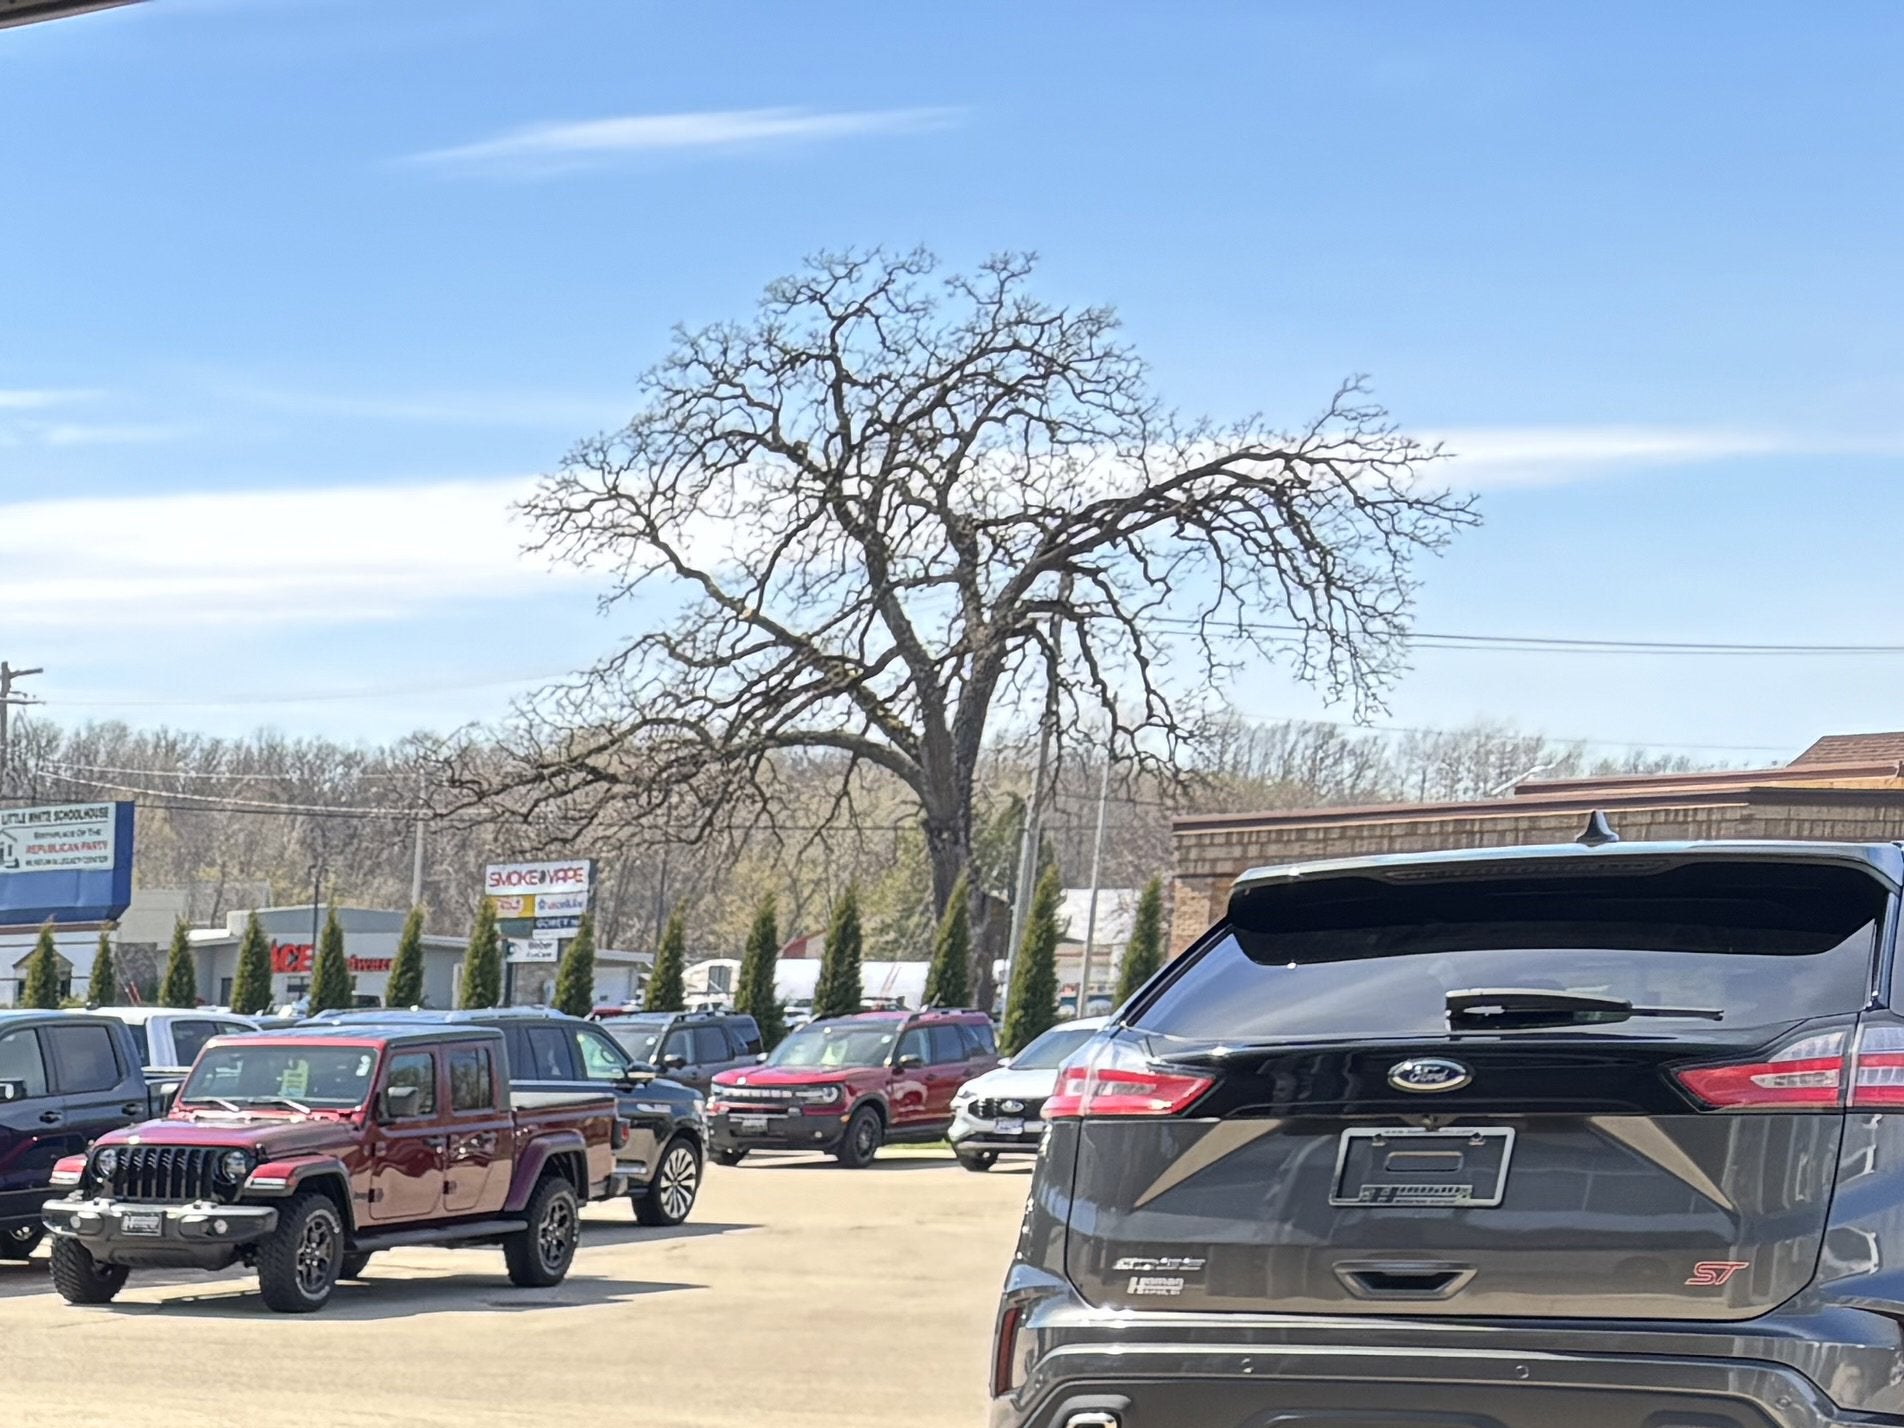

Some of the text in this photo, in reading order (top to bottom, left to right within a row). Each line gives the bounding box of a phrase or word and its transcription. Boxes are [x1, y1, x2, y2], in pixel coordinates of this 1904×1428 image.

[488, 869, 538, 887] SMOKE
[1408, 1064, 1449, 1083] Ford
[1684, 1261, 1750, 1286] ST
